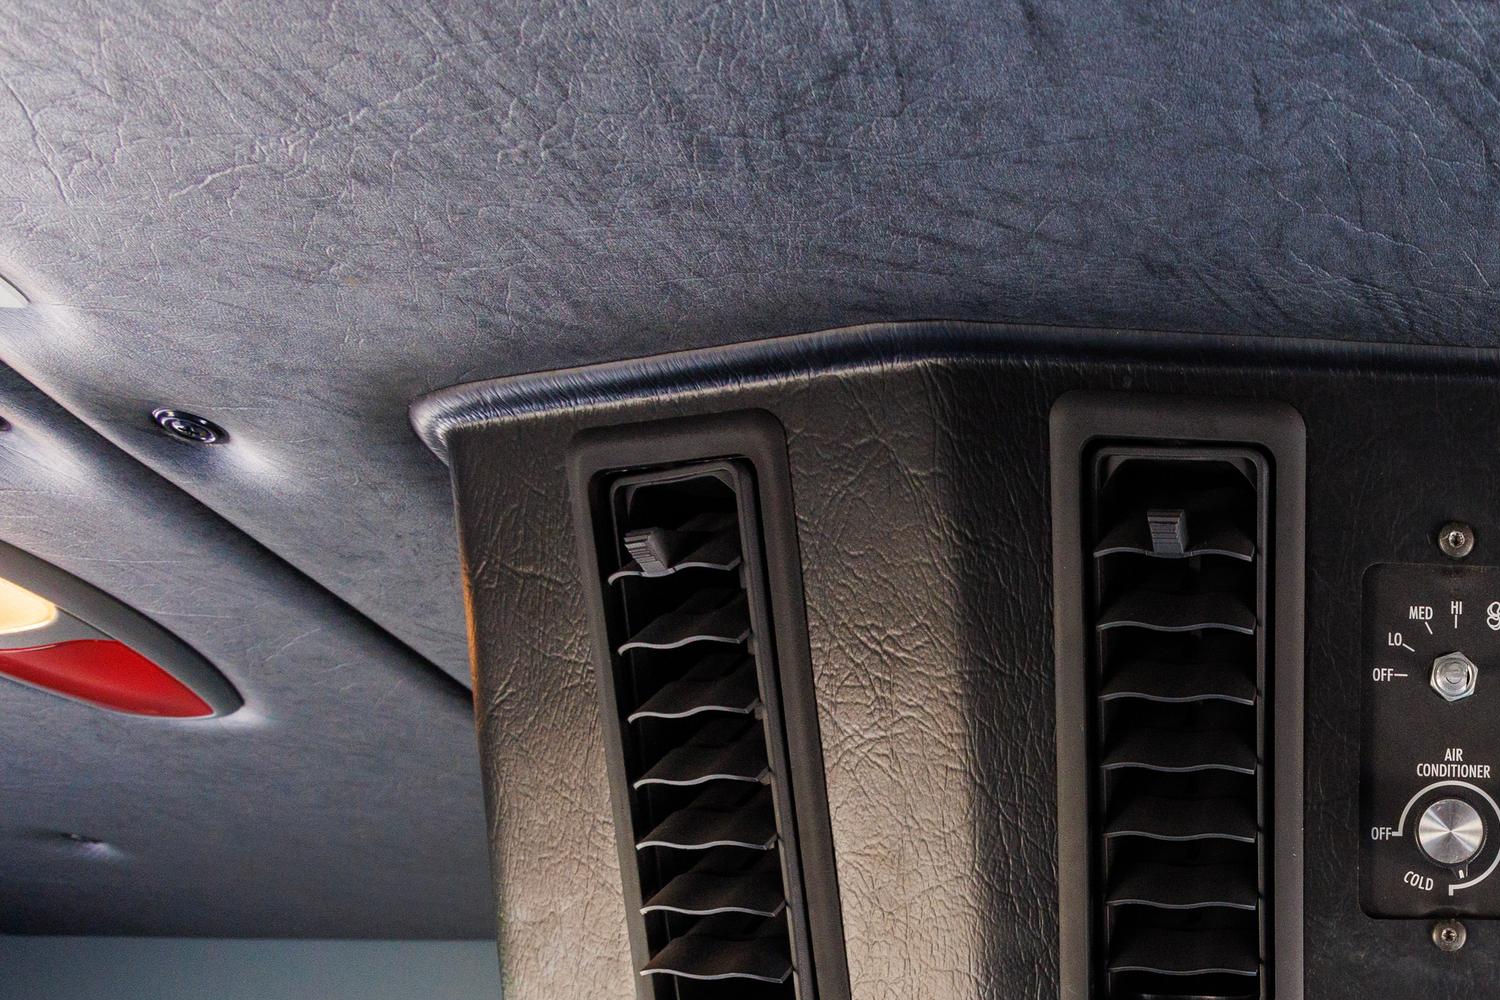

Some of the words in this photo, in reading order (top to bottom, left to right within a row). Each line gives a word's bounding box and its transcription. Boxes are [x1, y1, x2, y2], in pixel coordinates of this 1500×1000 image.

[1408, 605, 1434, 621] MED
[1450, 600, 1463, 615] HI
[1387, 632, 1403, 647] LO
[1372, 667, 1394, 682] OFF
[1444, 747, 1464, 762] AIR
[1416, 762, 1491, 779] CONDITIONER
[1370, 826, 1392, 841] OFF
[1403, 870, 1434, 891] COLD
